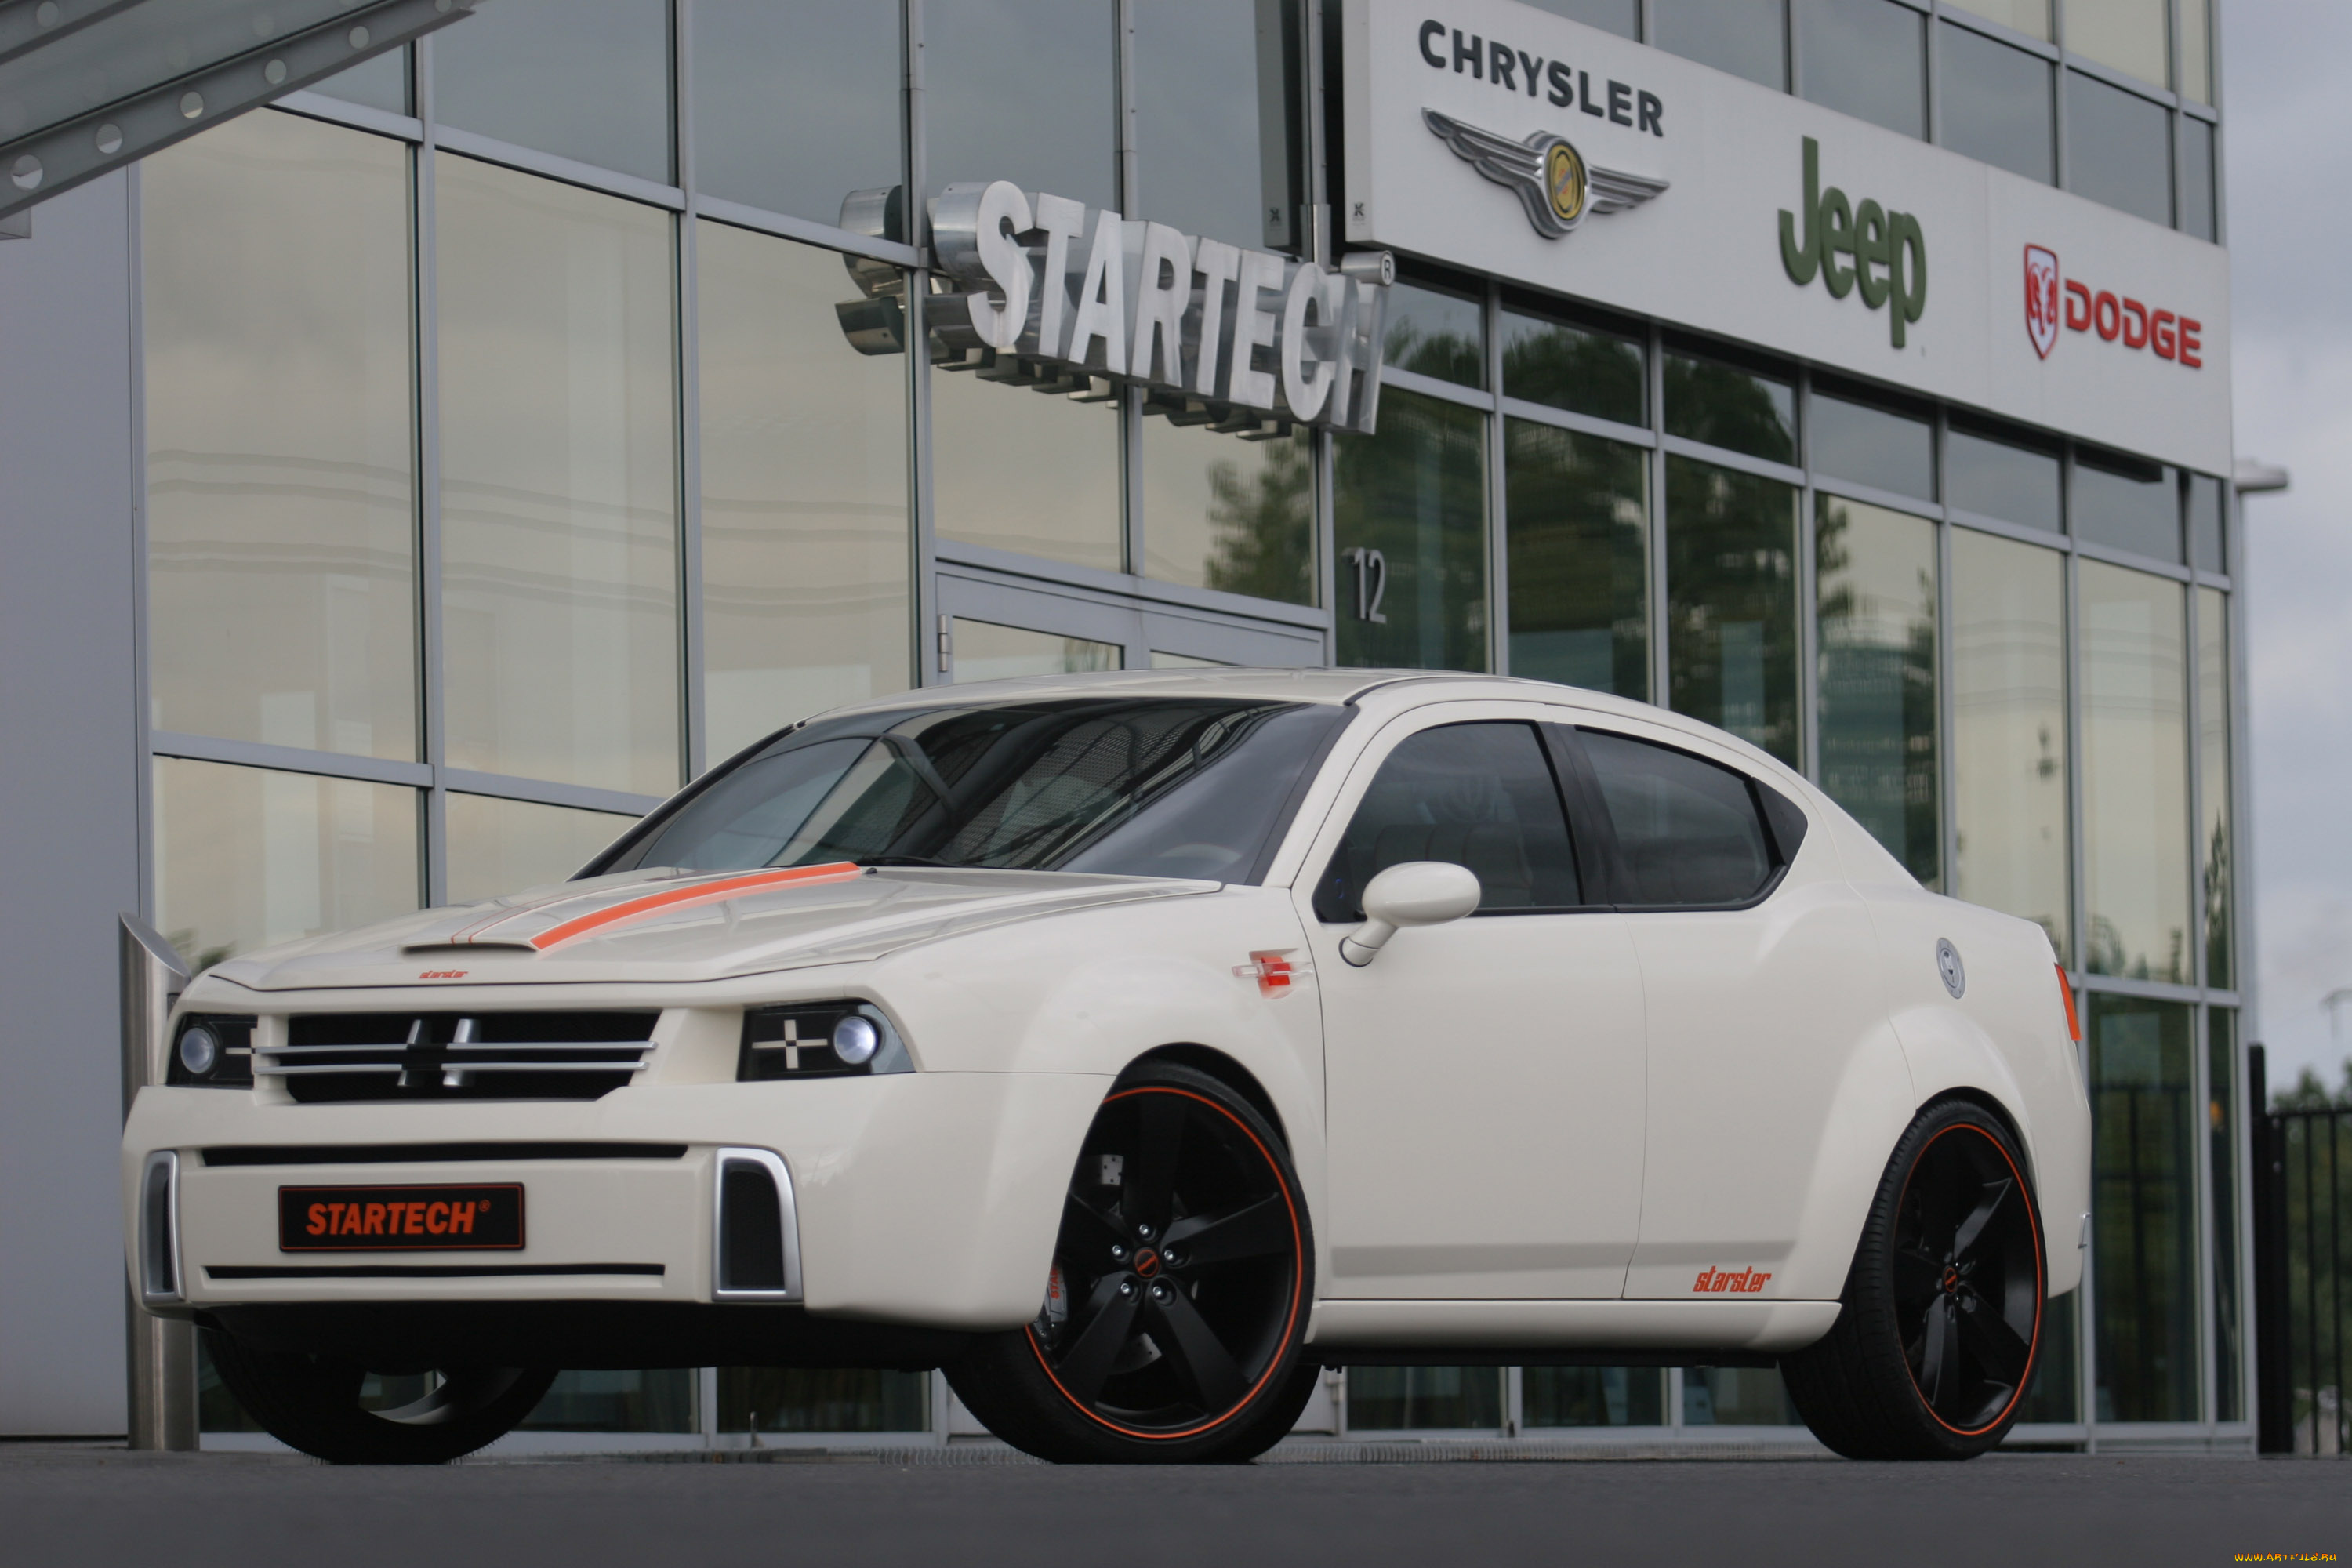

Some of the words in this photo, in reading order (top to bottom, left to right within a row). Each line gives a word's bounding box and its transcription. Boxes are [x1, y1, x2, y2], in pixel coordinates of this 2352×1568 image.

[1419, 19, 1664, 138] CHRYSLER
[1777, 135, 1926, 350] Jeep
[2064, 278, 2202, 368] DODGE
[1352, 547, 1387, 624] 12
[1692, 1265, 1772, 1293] starster
